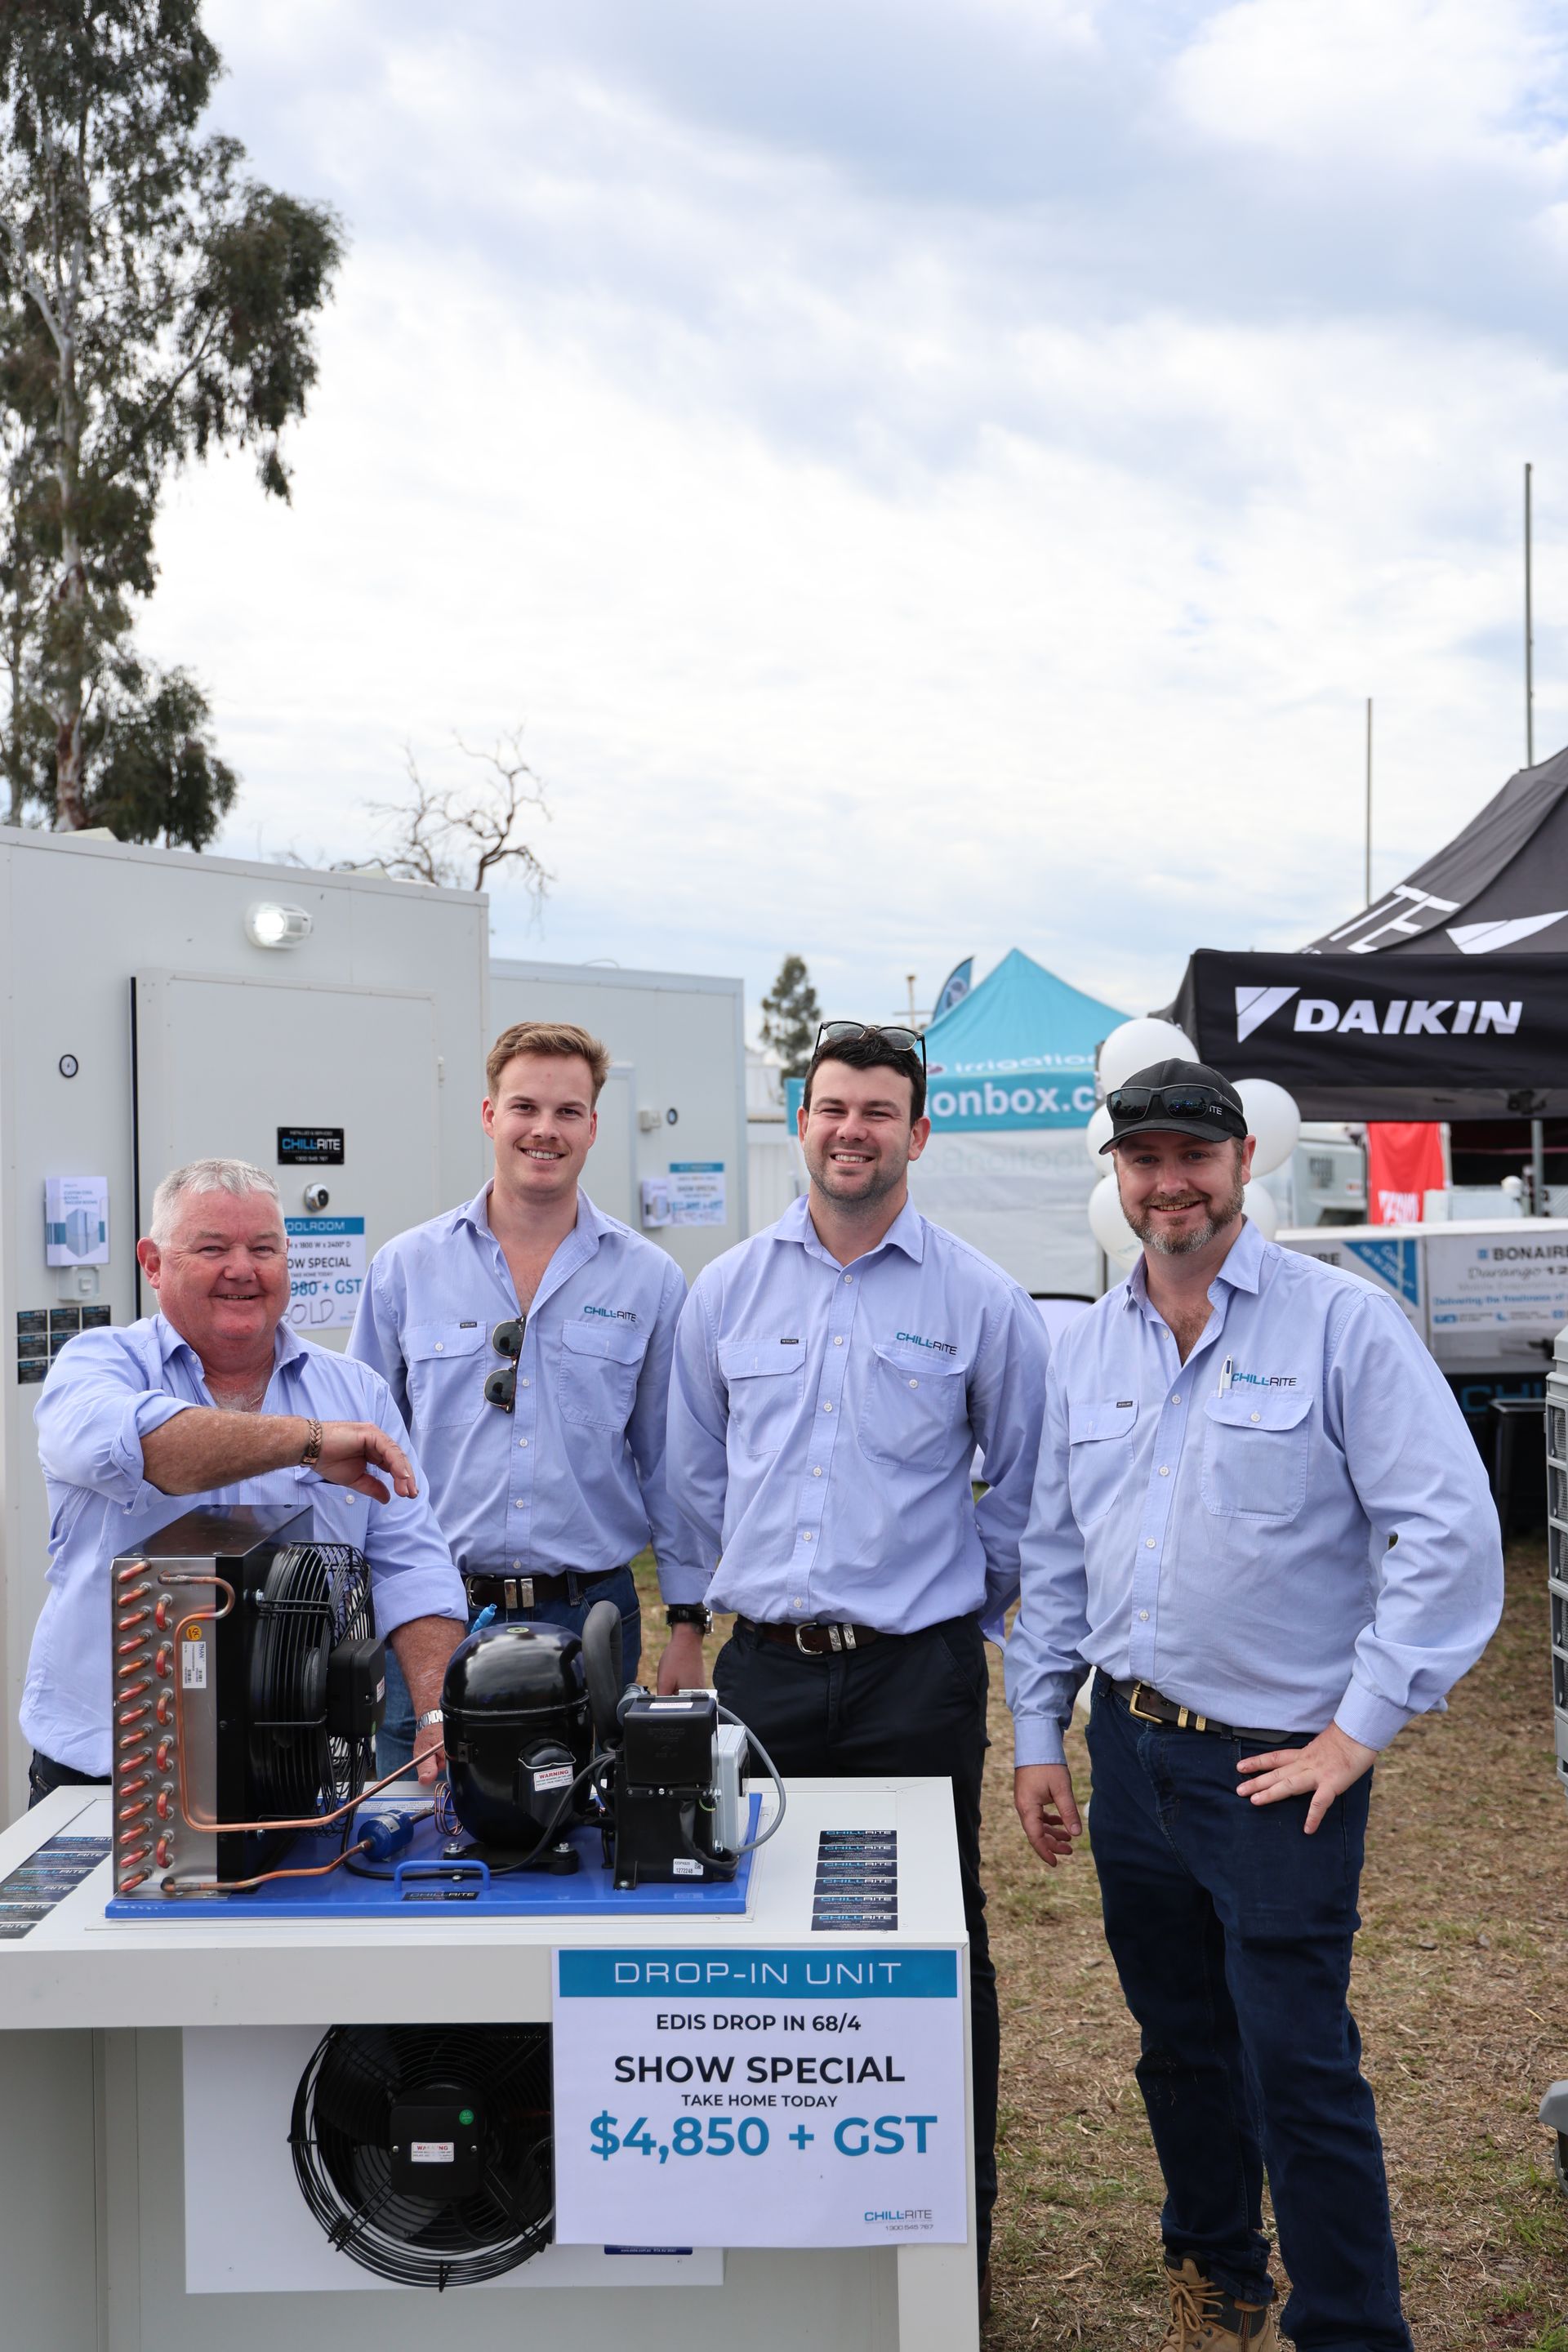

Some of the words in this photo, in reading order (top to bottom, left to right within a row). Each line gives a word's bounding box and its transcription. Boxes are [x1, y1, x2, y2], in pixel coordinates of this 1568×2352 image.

[1294, 999, 1523, 1035] DAIKIN
[286, 1222, 345, 1232] OOLROOM
[1492, 1245, 1568, 1261] BONAIR
[309, 1257, 351, 1268] SPECIAL
[335, 1278, 363, 1294] GST
[539, 1769, 569, 1780] WARNING
[614, 1962, 788, 1984] DROP-IN
[806, 1962, 902, 1984] UNIT
[656, 2014, 706, 2030] EDIS
[713, 2014, 777, 2031] DROP
[783, 2015, 804, 2032] IN
[812, 2012, 862, 2034] 68/4
[614, 2056, 734, 2083] SHOW
[746, 2056, 906, 2084] SPECIAL
[681, 2094, 724, 2107] TAKE
[728, 2094, 777, 2107] HOME
[782, 2095, 838, 2108] TODAY
[590, 2110, 769, 2164] $4,850
[789, 2124, 814, 2150] +
[834, 2115, 938, 2157] GST
